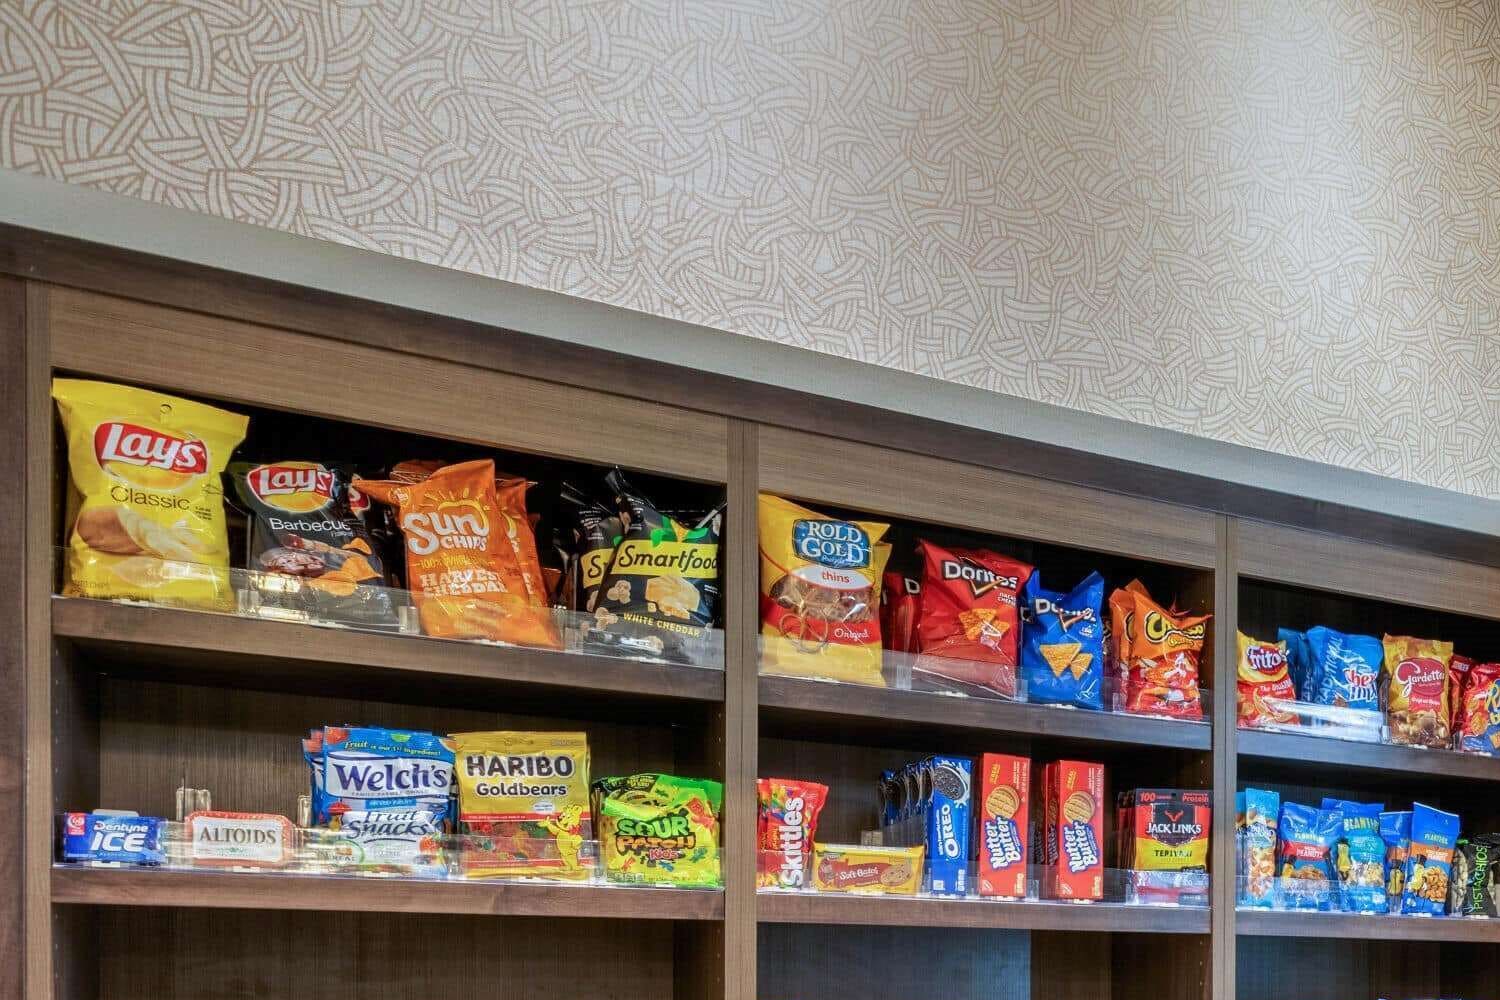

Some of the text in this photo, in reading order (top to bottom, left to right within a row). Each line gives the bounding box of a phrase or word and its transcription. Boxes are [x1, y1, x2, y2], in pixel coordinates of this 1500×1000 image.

[111, 486, 190, 511] Classic
[403, 511, 490, 556] Sun
[808, 521, 862, 543] ROLD
[440, 535, 488, 552] CHIPS
[801, 537, 864, 564] GOLD
[822, 571, 851, 584] thins
[623, 612, 701, 638] WHITE CHEDDAR
[466, 755, 573, 777] HARIBO
[332, 763, 448, 791] Welch's
[476, 783, 567, 796] Goldbears
[1140, 792, 1155, 801] 100
[364, 810, 418, 823] Fruit
[94, 821, 148, 833] Dentyne
[200, 826, 276, 844] ALTOIDS
[347, 820, 428, 839] Snacks
[617, 816, 689, 839] SOUR
[941, 804, 960, 858] OREO
[1146, 823, 1171, 834] JACK
[90, 833, 145, 851] ICE
[1473, 845, 1488, 910] PISTACHIOS
